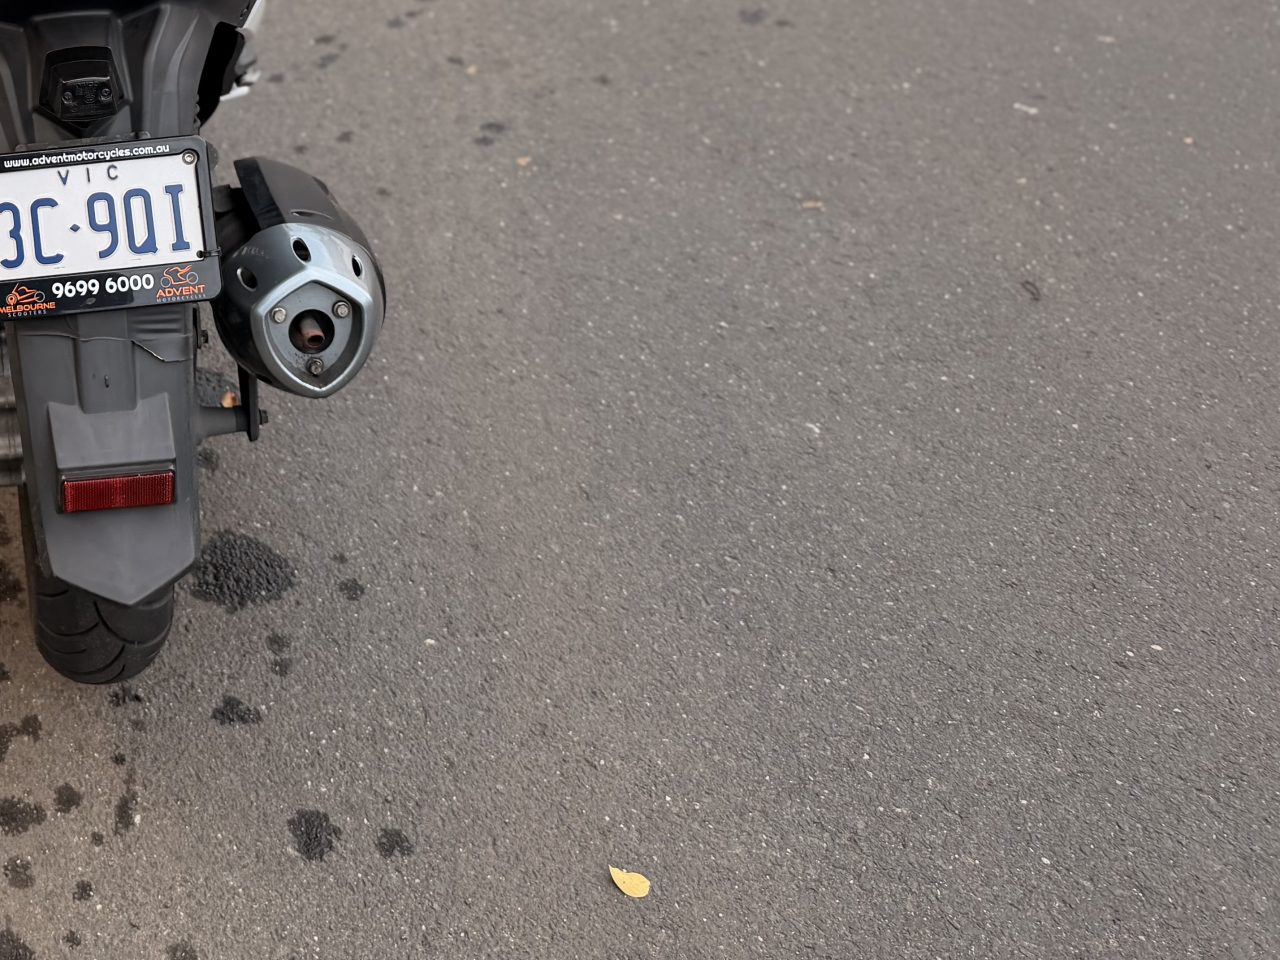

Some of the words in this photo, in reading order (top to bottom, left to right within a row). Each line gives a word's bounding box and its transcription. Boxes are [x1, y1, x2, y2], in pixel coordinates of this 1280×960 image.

[4, 143, 170, 168] www.adventmotorcycles.com.au
[57, 164, 118, 186] VIC
[51, 279, 100, 299] 9699
[105, 273, 155, 294] 6000
[156, 284, 206, 298] ADVENT
[7, 310, 48, 318] SCOOTERS
